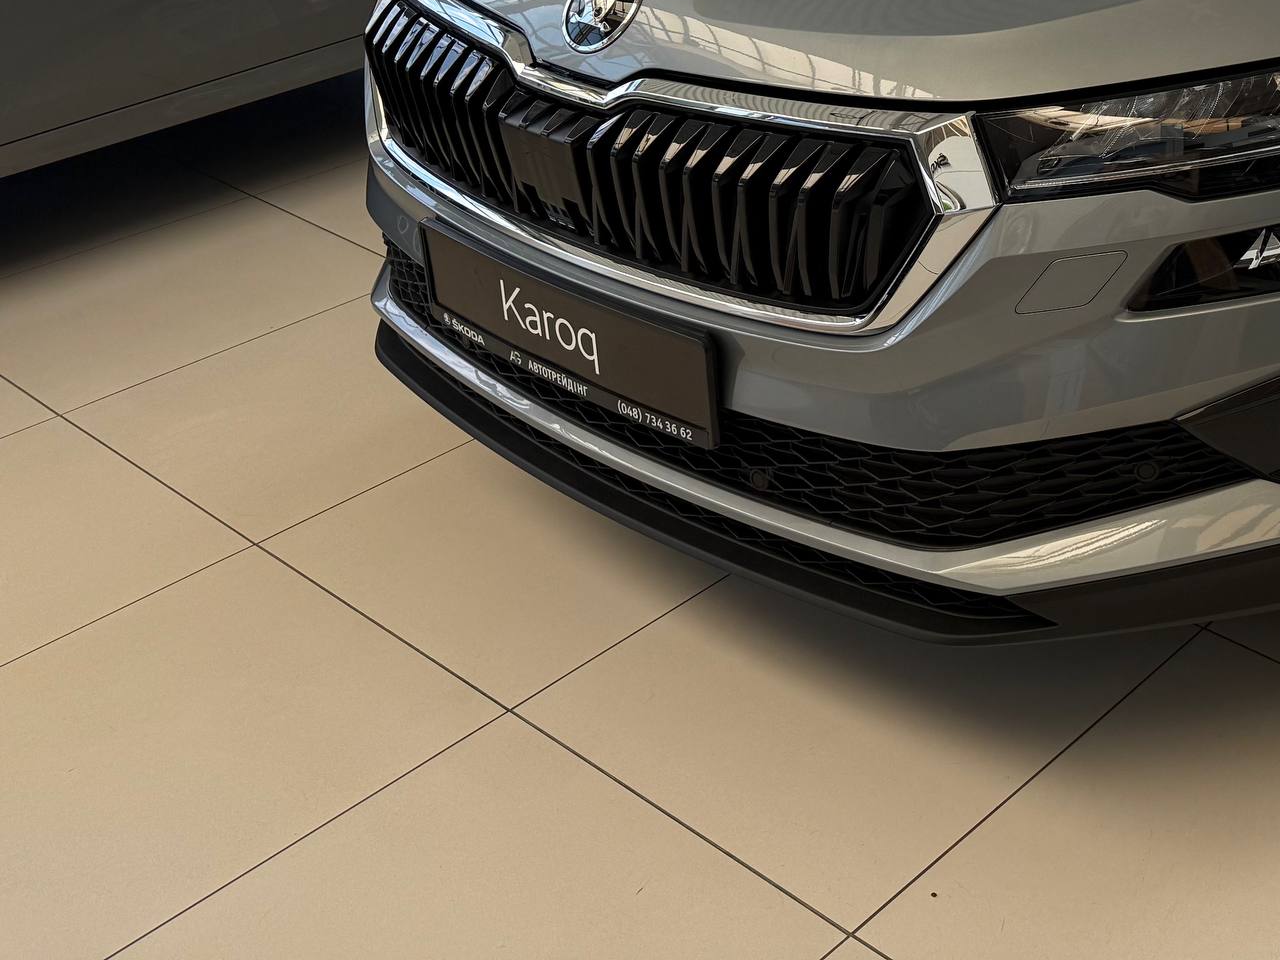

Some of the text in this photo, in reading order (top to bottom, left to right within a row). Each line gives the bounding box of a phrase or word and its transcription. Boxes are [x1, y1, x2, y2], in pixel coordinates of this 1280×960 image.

[451, 318, 486, 346] ŠKODA
[499, 279, 600, 376] Karoq
[528, 359, 588, 397] АВТОТРЕЙДІНГ
[617, 399, 693, 441] (048) 734 36 62
